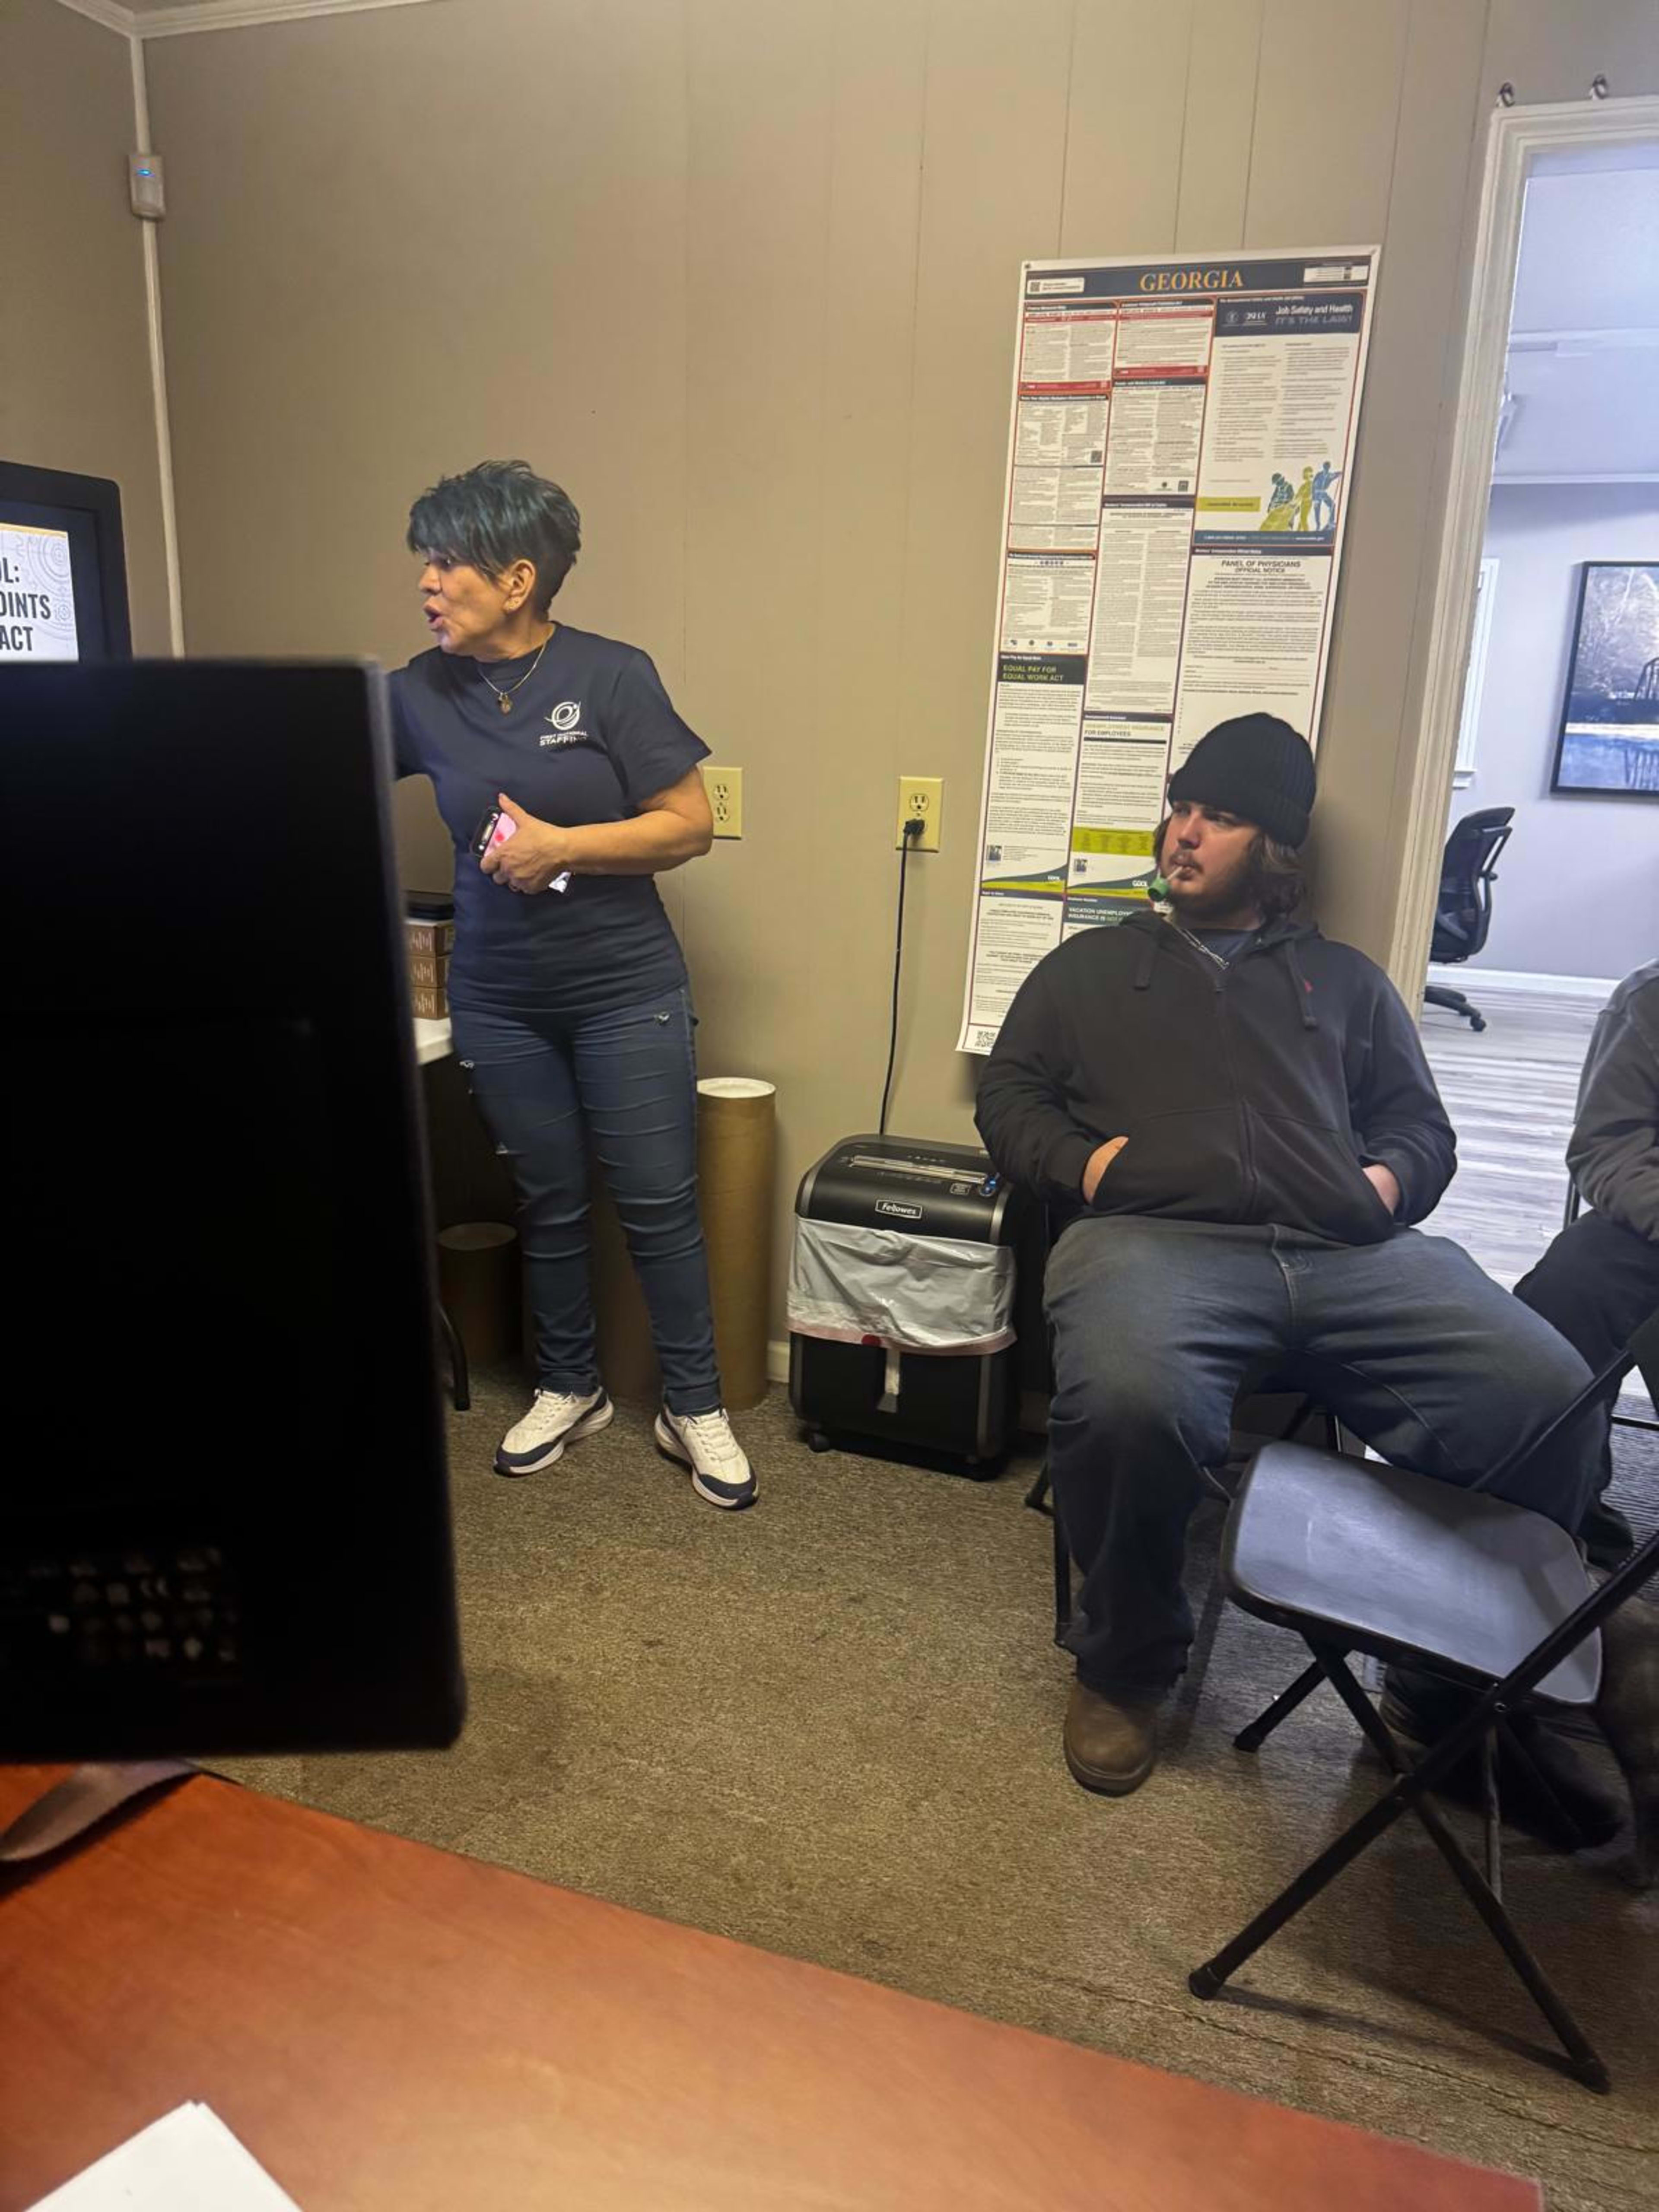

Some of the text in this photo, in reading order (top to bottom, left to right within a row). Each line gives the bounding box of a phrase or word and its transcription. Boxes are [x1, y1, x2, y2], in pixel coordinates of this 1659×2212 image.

[1140, 270, 1243, 291] GEORGIA
[1275, 303, 1353, 315] Job Safety and Health
[0, 557, 19, 583] L:
[882, 1202, 916, 1215] Fellowes
